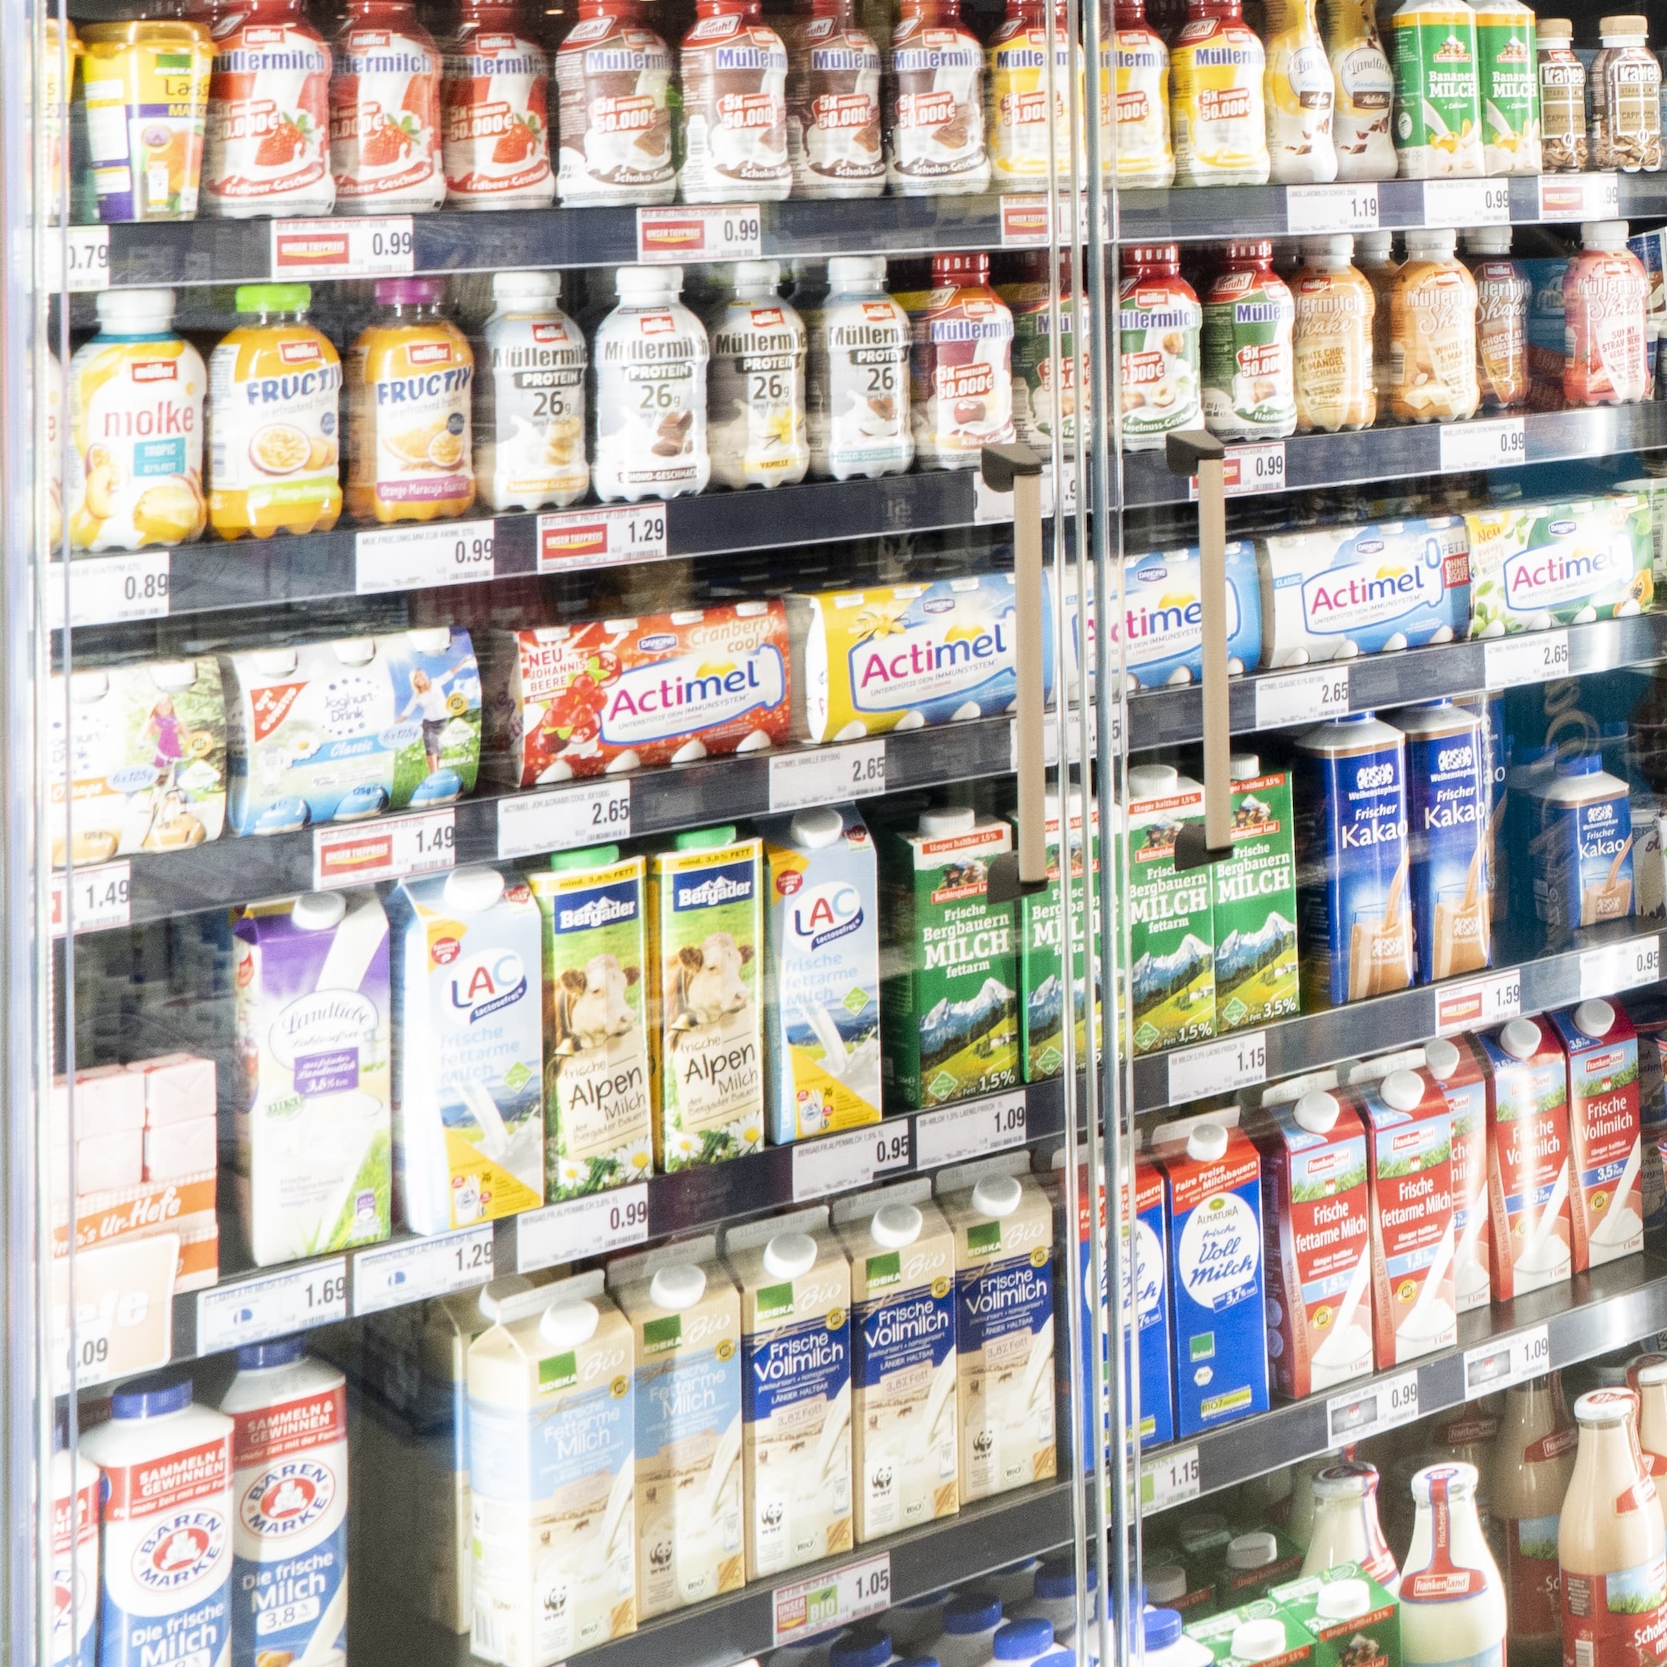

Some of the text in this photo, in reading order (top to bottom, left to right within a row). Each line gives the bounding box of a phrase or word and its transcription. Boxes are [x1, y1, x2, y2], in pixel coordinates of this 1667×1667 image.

[246, 29, 284, 43] müller
[1428, 70, 1477, 83] Bananen
[1428, 82, 1478, 98] MILCH
[1351, 198, 1377, 217] 1.19
[1485, 190, 1509, 209] 0.99
[372, 232, 413, 256] 0.99
[410, 345, 450, 361] müller
[133, 365, 175, 381] müller
[628, 365, 690, 380] PROTEIN
[377, 369, 472, 405] FRUCTIV
[103, 400, 194, 437] molke
[144, 444, 176, 457] TROPIC
[760, 458, 790, 469] VANILLE
[1256, 456, 1283, 476] 0.99
[628, 519, 665, 544] 1.29
[455, 539, 494, 565] 0.99
[1512, 544, 1618, 592] Actimel
[124, 575, 169, 601] 0.89
[1310, 564, 1425, 614] Actimel
[642, 638, 675, 650] DANONE
[689, 616, 777, 649] Cranberry
[727, 635, 761, 654] cool
[528, 649, 563, 669] NEU
[860, 622, 1008, 689] Actimel
[1544, 645, 1568, 665] 2.65
[530, 675, 568, 692] BEERE
[610, 659, 761, 721] Actimel
[1321, 682, 1349, 704] 2.65
[852, 757, 885, 781] 2.65
[592, 801, 630, 825] 2.65
[1355, 803, 1397, 820] Frischer
[416, 826, 455, 851] 1.49
[1341, 816, 1409, 850] Kakao
[1586, 827, 1615, 842] Frischer
[1579, 838, 1625, 860] Kakao
[1217, 851, 1290, 878] Bergbauern
[86, 879, 130, 906] 1.49
[679, 879, 752, 907] Bergader
[1217, 866, 1291, 903] MILCH
[560, 898, 636, 930] Bergader
[795, 887, 857, 926] LAC
[944, 904, 986, 922] Frische
[923, 912, 1010, 943] Bergbauern
[924, 929, 1010, 970] MILCH
[946, 962, 990, 979] fettarm
[1263, 997, 1296, 1019] 3,5%
[1496, 984, 1520, 1008] 1.59
[684, 1043, 756, 1085] Alpen
[1237, 1047, 1265, 1073] 1.15
[569, 1065, 643, 1111] Alpen
[718, 1067, 758, 1096] Milch
[979, 1070, 1015, 1091] 1,5%
[604, 1091, 647, 1122] Milch
[994, 1107, 1026, 1130] 1.09
[1587, 1095, 1627, 1118] Frische
[1582, 1111, 1633, 1142] Vollmilch
[877, 1137, 909, 1162] 0.95
[1175, 1164, 1226, 1194] Faire Preise
[1202, 1159, 1258, 1191] Milchbauern
[610, 1202, 648, 1227] 0.99
[1313, 1200, 1349, 1226] Frische
[1296, 1215, 1367, 1254] fettarme Milch
[1199, 1240, 1240, 1266] Voll
[1189, 1255, 1253, 1288] Milch
[305, 1277, 346, 1309] 1.69
[878, 1300, 934, 1325] Frische
[865, 1312, 949, 1349] Vollmilch
[770, 1333, 829, 1357] Frische
[754, 1343, 845, 1382] Vollmilch
[1391, 1381, 1418, 1410] 0.99
[247, 1405, 321, 1434] SAMMELN
[250, 1414, 331, 1445] GEWINNEN
[248, 1462, 325, 1504] BÄREN
[250, 1497, 324, 1538] MARKE
[242, 1550, 333, 1593] Die frische
[855, 1570, 890, 1598] 1.05
[251, 1575, 325, 1614] Milch
